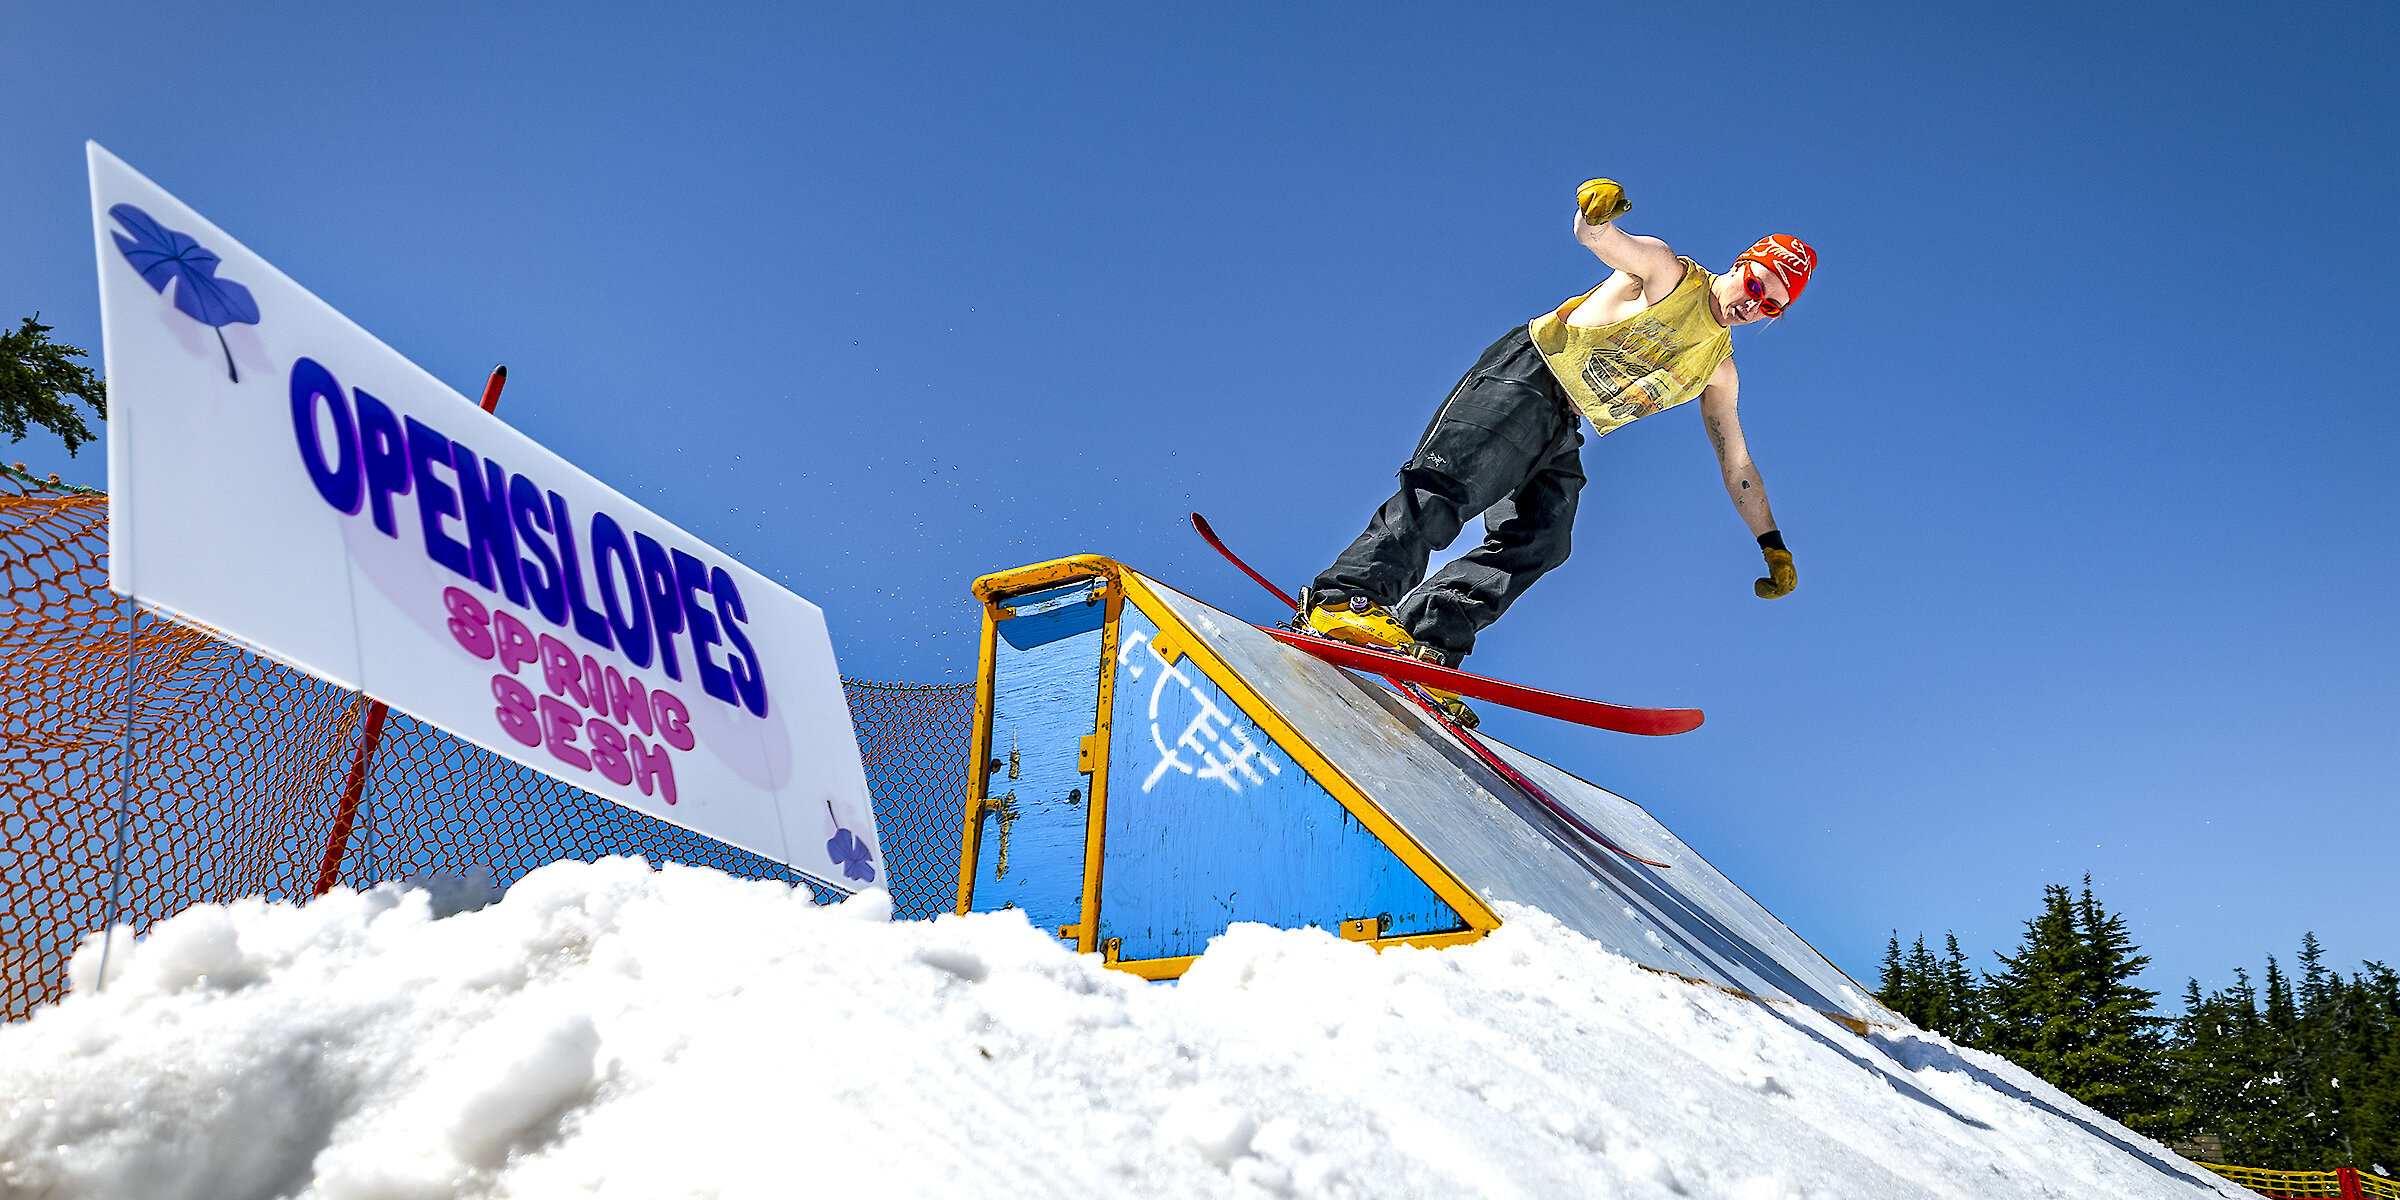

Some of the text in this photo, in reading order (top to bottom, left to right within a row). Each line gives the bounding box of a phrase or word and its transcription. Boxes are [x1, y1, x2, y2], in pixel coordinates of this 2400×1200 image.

[289, 356, 769, 719] OPENSLOPES
[442, 585, 696, 752] SPRING
[490, 672, 679, 805] SESH
